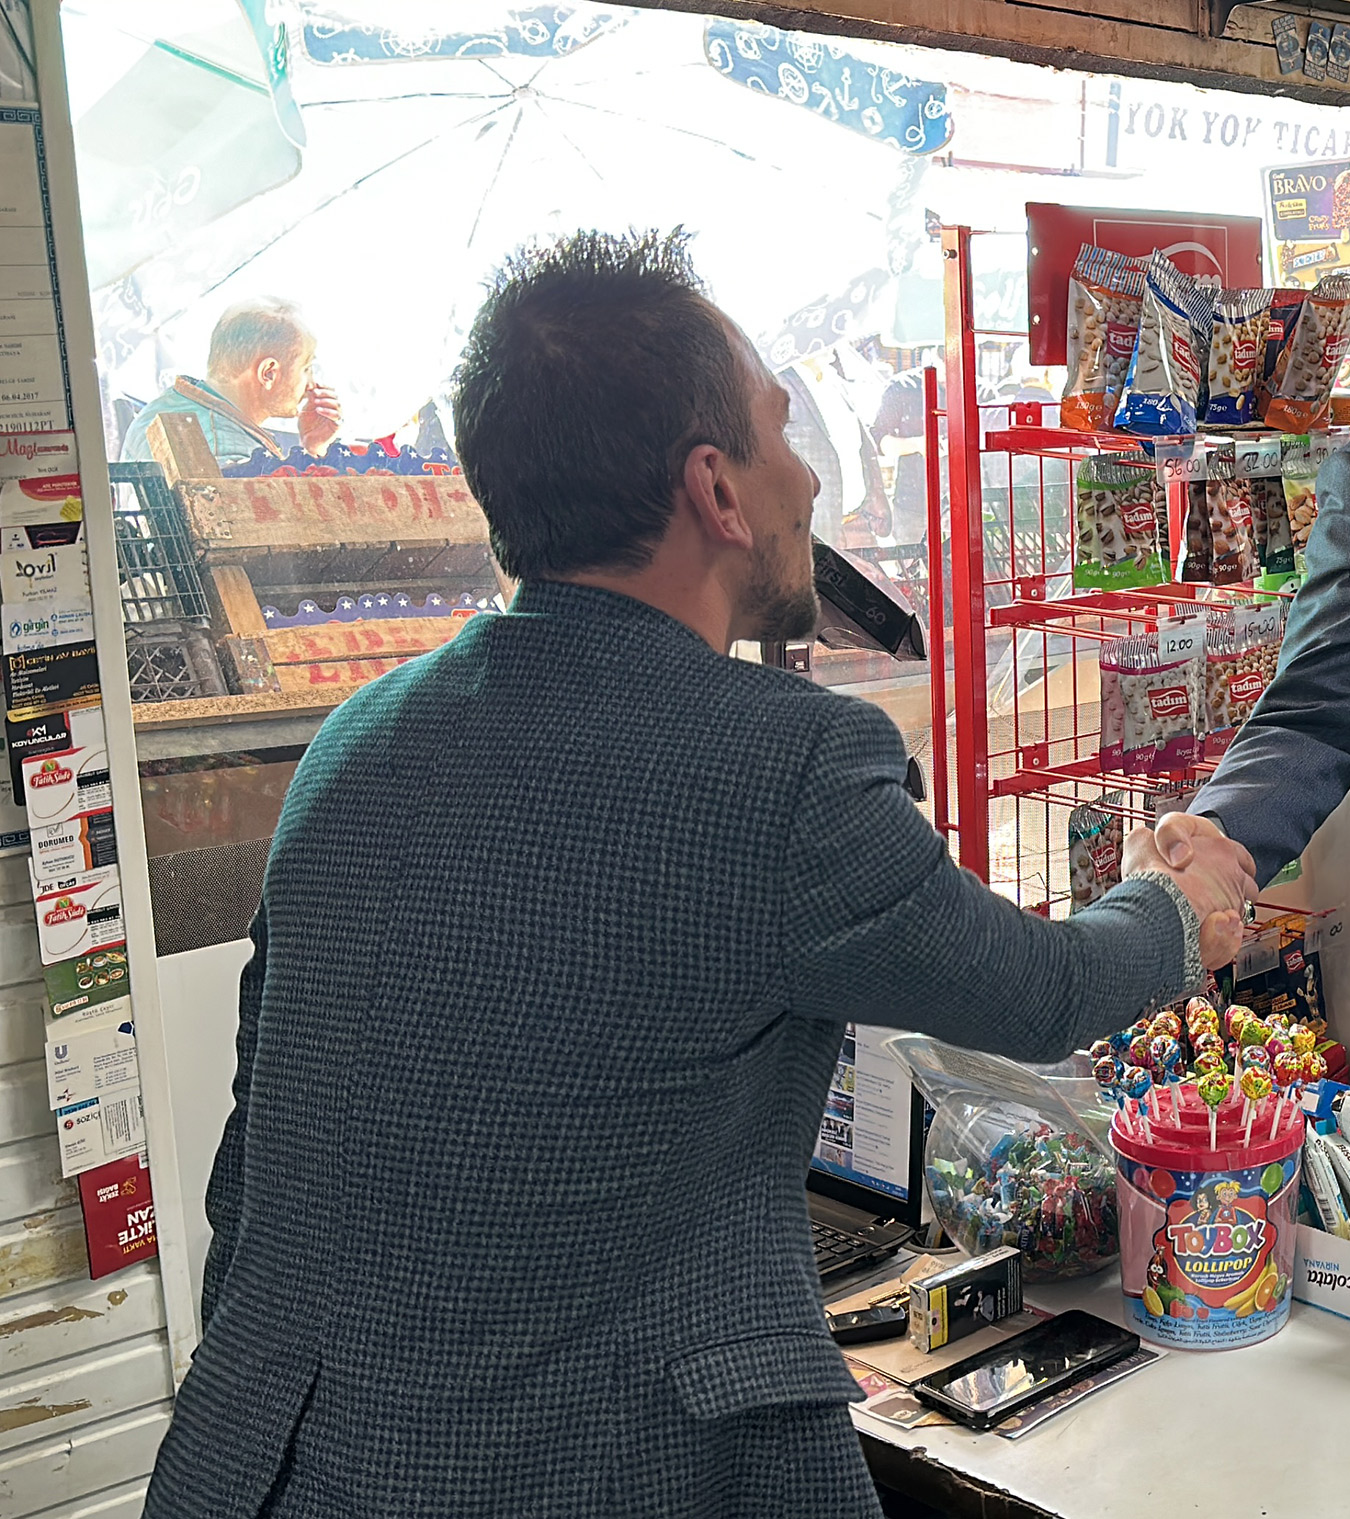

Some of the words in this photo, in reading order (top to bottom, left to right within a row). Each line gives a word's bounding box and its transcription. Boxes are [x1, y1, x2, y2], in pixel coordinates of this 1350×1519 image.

[1124, 101, 1188, 141] YOK
[1273, 174, 1327, 195] BRAVO
[1109, 332, 1134, 347] tad
[1123, 511, 1153, 524] tadım
[1166, 638, 1193, 653] 12.00
[1230, 679, 1262, 692] tadım
[1150, 693, 1187, 708] tadım
[12, 732, 67, 748] KOYUNCULAR
[40, 884, 54, 894] JDE
[1185, 1257, 1252, 1272] LOLLIPOP
